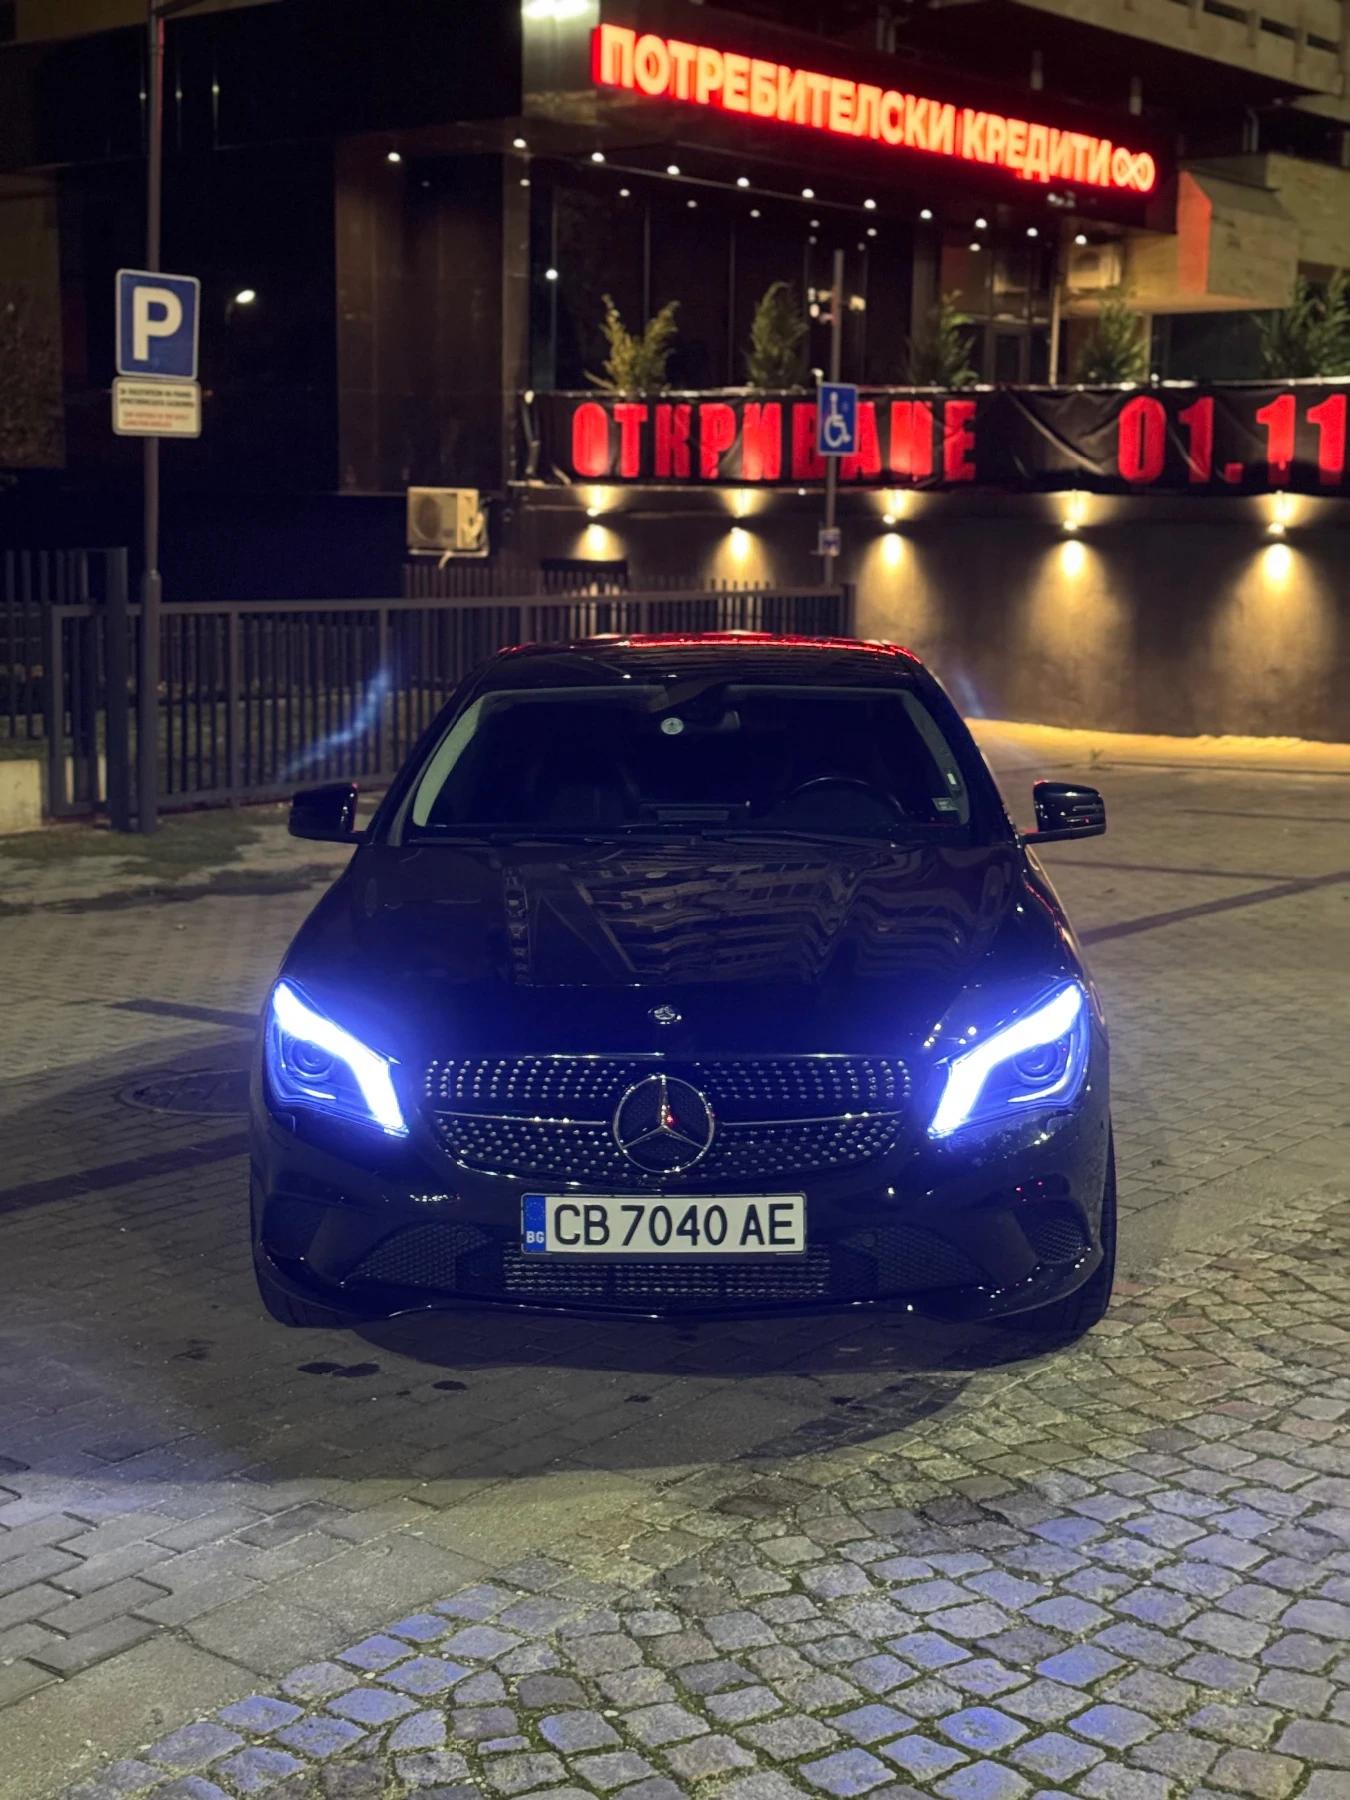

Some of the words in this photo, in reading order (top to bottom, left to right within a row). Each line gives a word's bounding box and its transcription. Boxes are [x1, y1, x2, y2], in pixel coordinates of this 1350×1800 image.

[594, 23, 956, 155] ПОТРЕБИТЕЛСКИ
[960, 108, 1113, 187] КРЕДИТИ
[133, 286, 183, 361] P
[526, 1231, 545, 1243] BG
[554, 1204, 610, 1245] CB
[621, 1205, 728, 1246] 7040
[739, 1203, 796, 1245] AE
